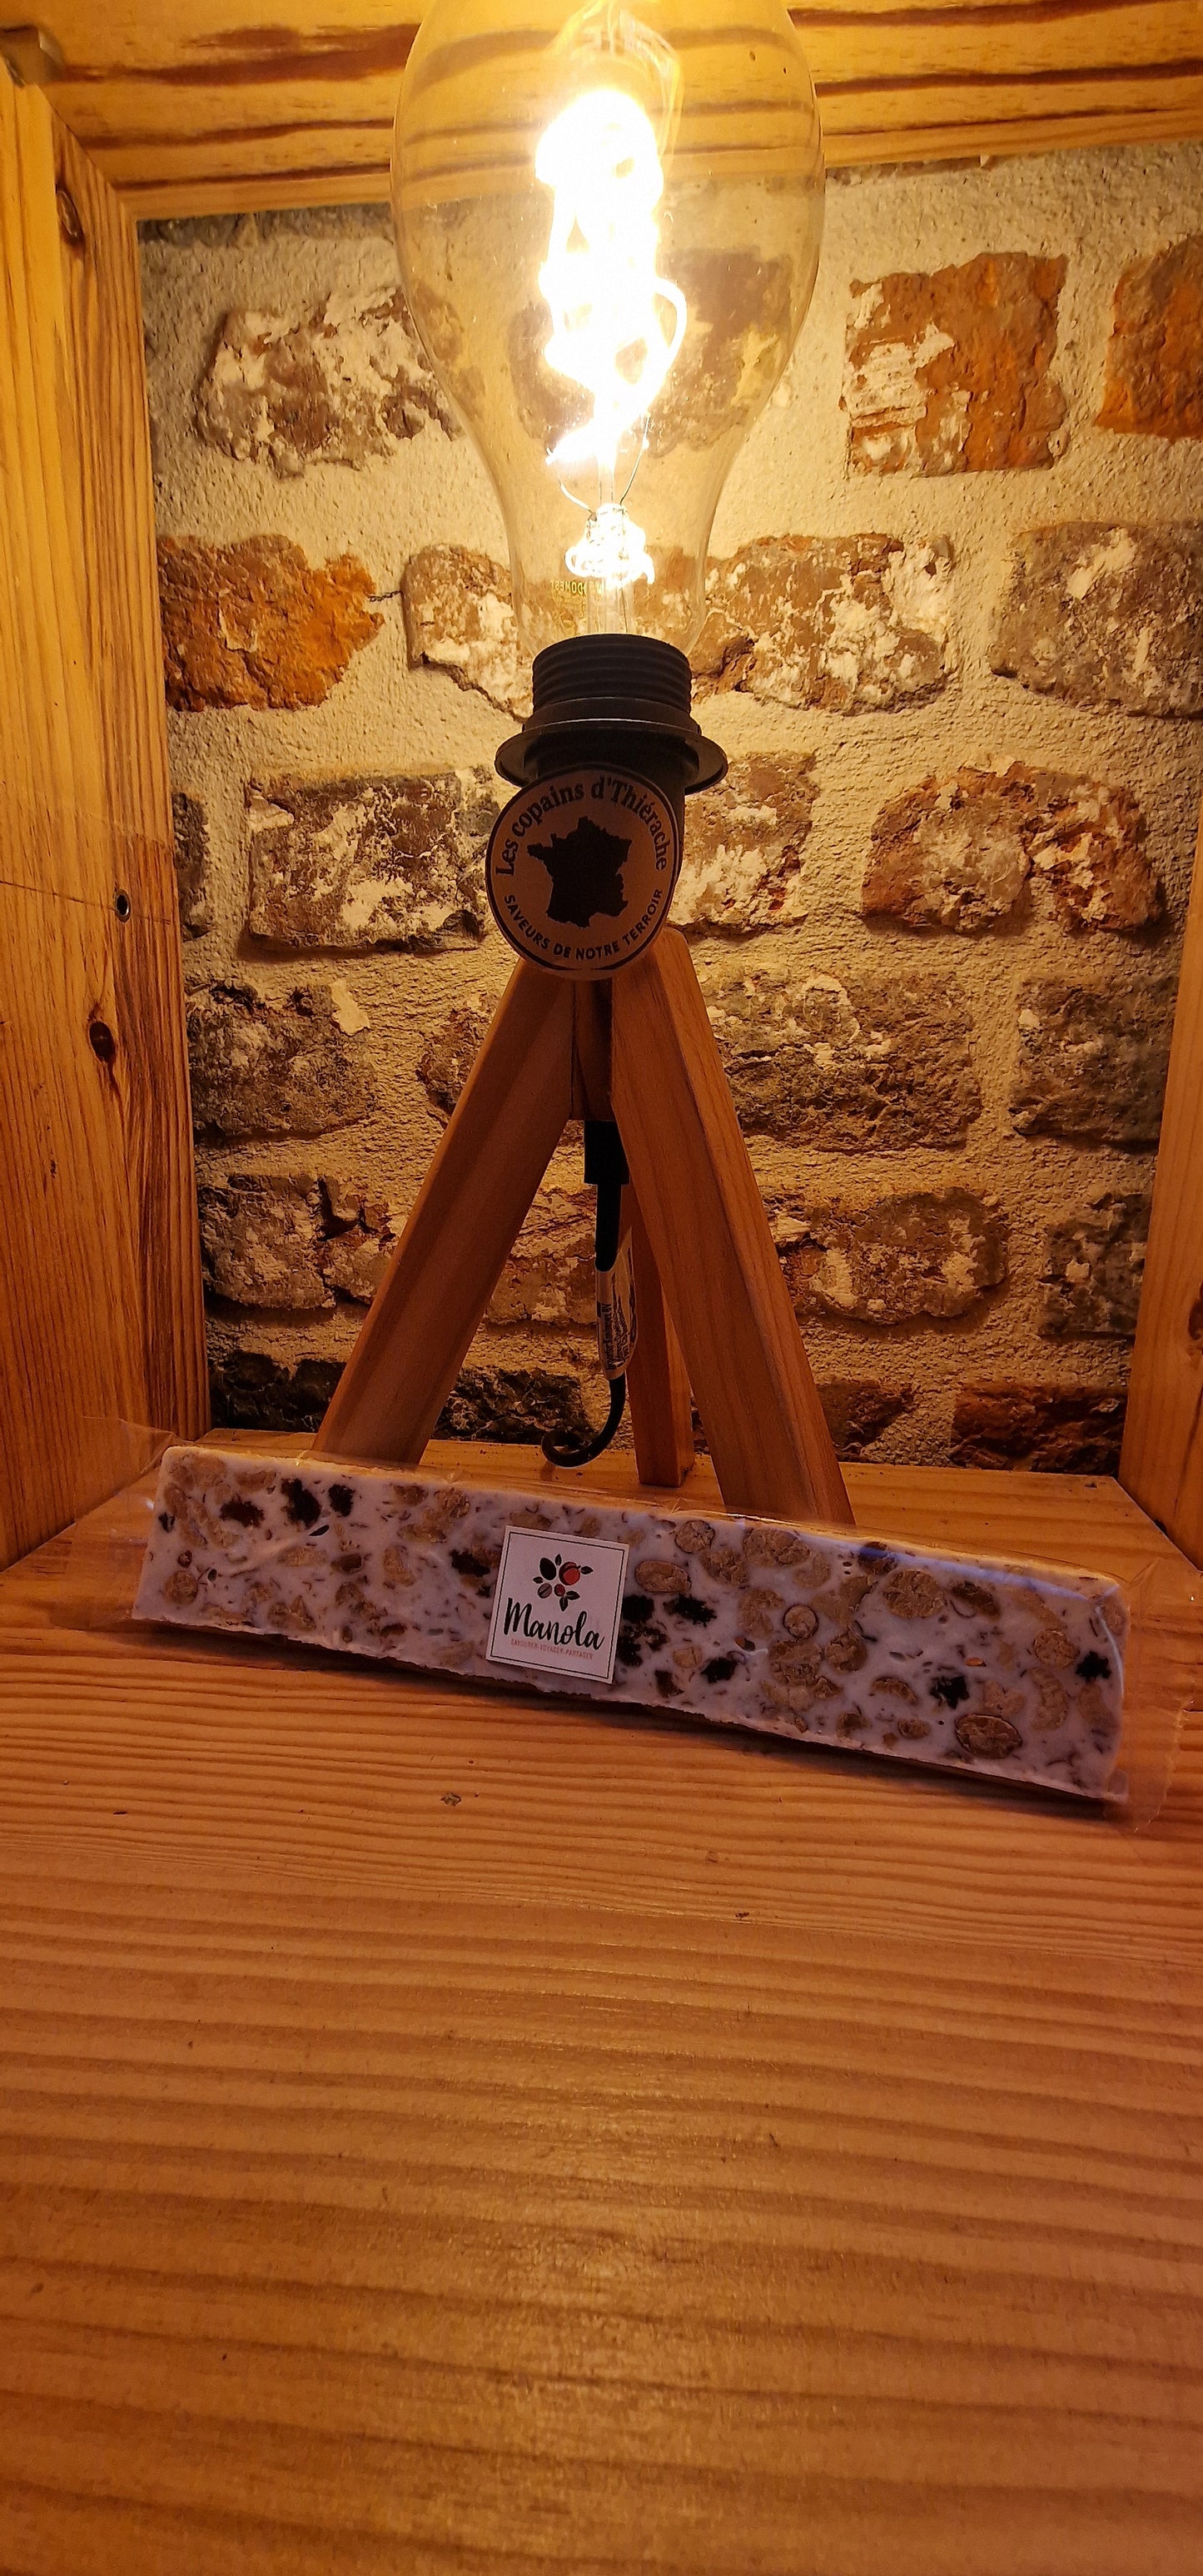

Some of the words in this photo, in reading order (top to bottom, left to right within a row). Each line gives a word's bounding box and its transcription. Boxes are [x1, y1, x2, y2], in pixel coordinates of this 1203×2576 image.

[495, 838, 519, 876] Les
[511, 783, 585, 837] copains
[590, 776, 671, 871] d'Thiérache
[504, 893, 549, 950] SAVEURS
[553, 942, 572, 957] DE
[575, 940, 621, 961] NOTRE
[622, 888, 663, 946] TERROIR
[503, 1597, 605, 1650] Manola
